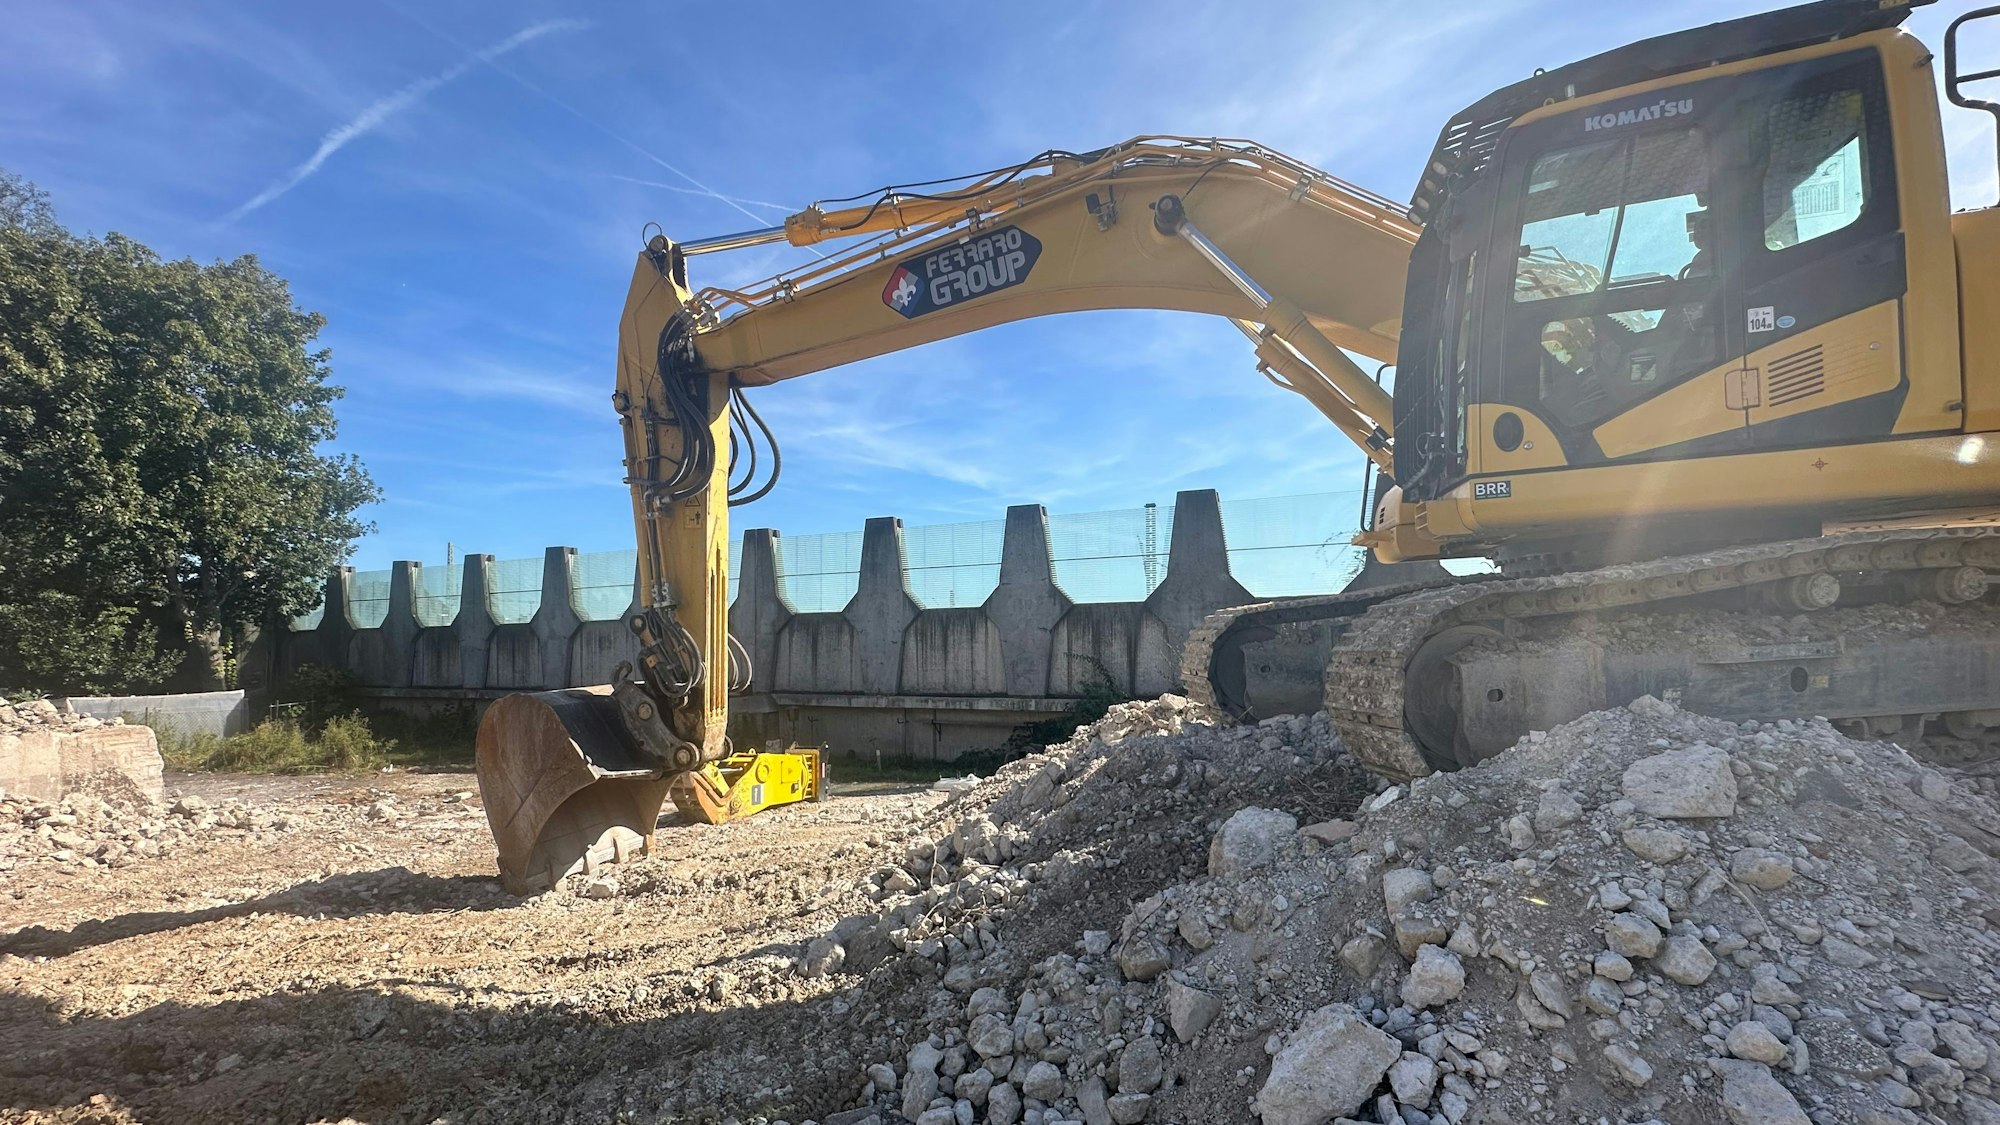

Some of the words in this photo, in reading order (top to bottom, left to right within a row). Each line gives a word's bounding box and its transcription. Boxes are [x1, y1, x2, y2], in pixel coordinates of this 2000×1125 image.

[1584, 98, 1693, 132] KOMATSU
[925, 228, 1022, 279] FERRARO
[929, 250, 1026, 306] GROUP
[1750, 317, 1766, 331] 104
[1475, 482, 1508, 496] BRR
